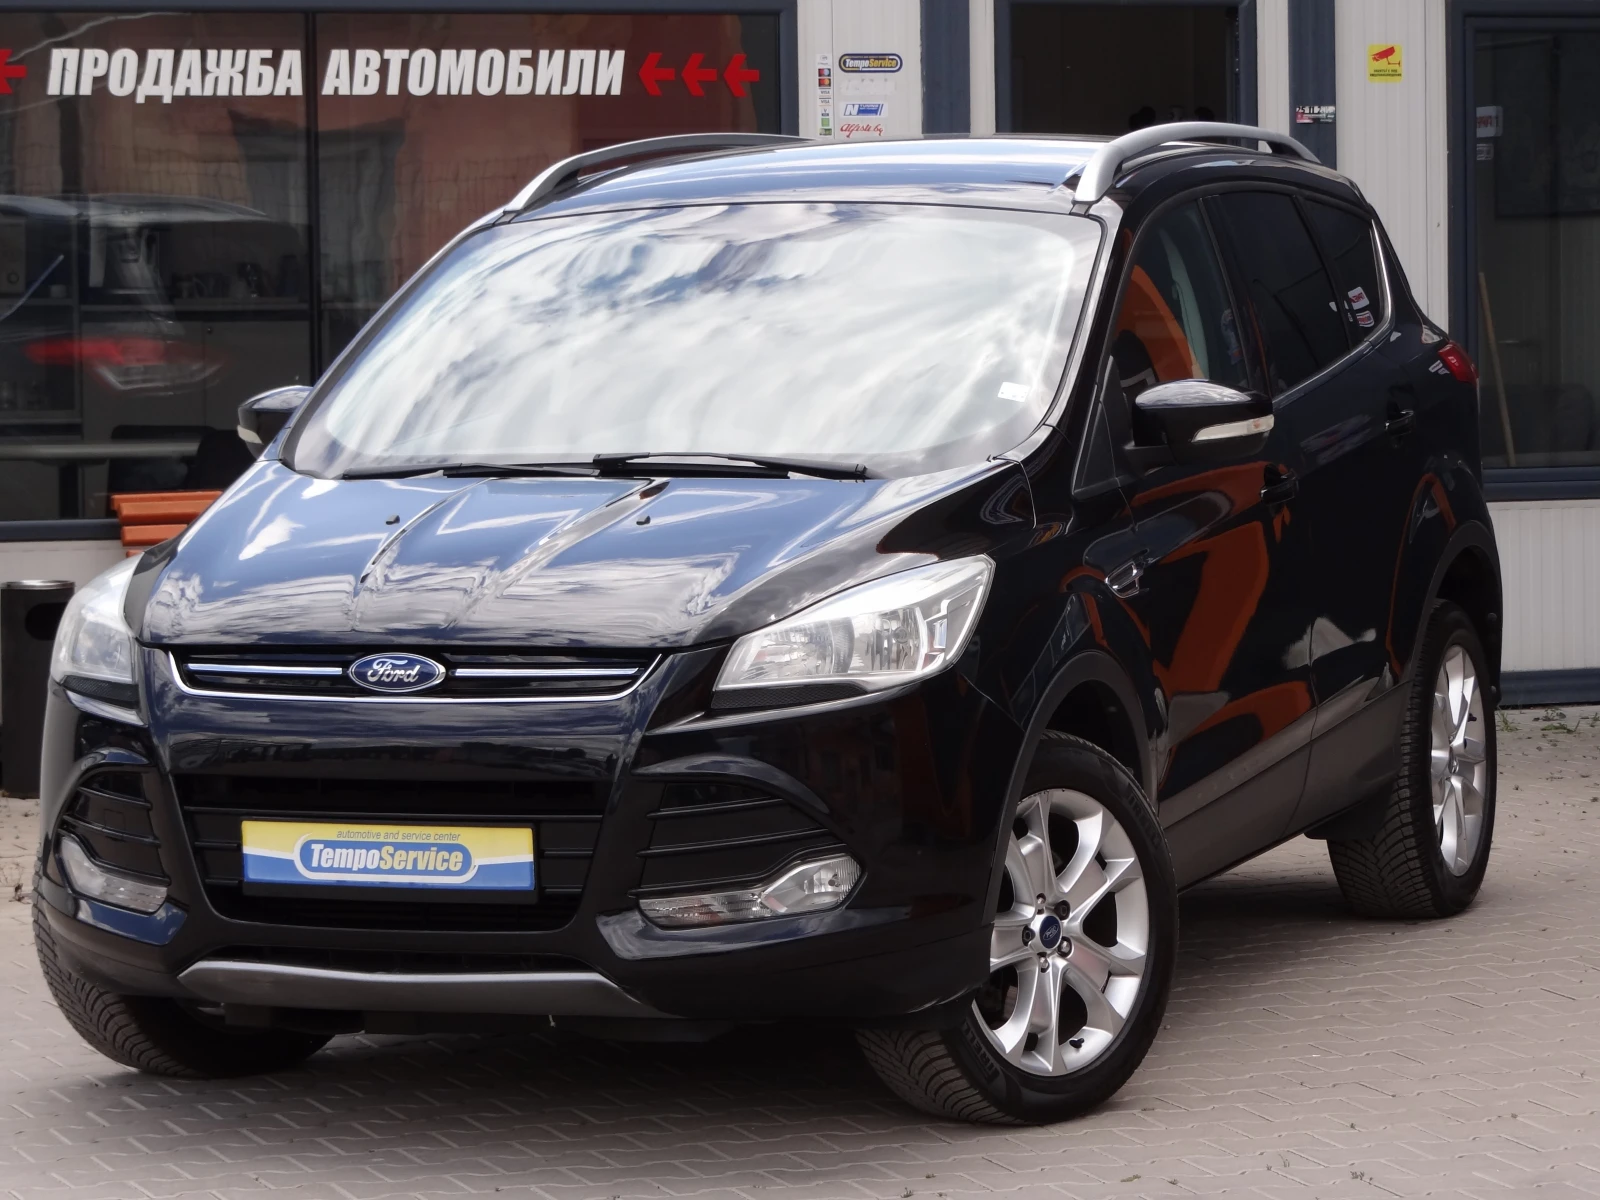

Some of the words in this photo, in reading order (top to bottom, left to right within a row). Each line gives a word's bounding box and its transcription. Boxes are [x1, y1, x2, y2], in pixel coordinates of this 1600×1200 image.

[47, 48, 303, 104] ПРОДАЖБА
[321, 48, 626, 97] АВТОМОБИЛИ
[845, 58, 897, 70] TempoService
[367, 658, 421, 683] Ford
[336, 830, 381, 840] automotive
[383, 831, 400, 840] and
[401, 832, 432, 841] service
[433, 832, 461, 842] center
[310, 843, 463, 872] TempoService
